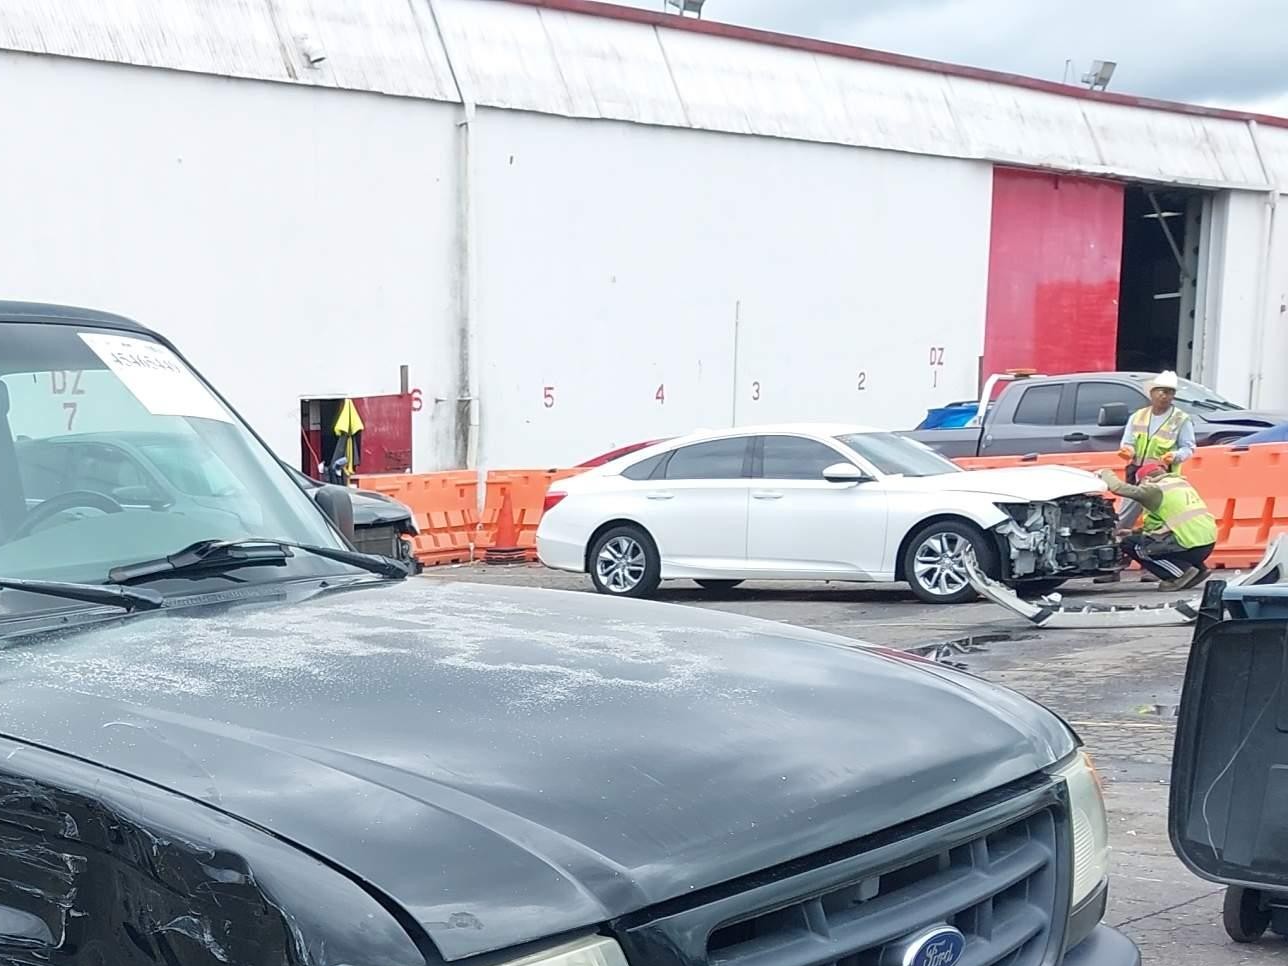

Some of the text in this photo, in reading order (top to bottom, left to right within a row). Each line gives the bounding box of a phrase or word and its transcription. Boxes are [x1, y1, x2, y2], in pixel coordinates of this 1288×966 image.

[929, 346, 945, 366] DZ
[752, 380, 761, 401] 3
[857, 371, 866, 390] 2
[411, 388, 423, 412] 6
[543, 386, 555, 408] 5
[655, 383, 665, 405] 4
[63, 402, 78, 431] 7
